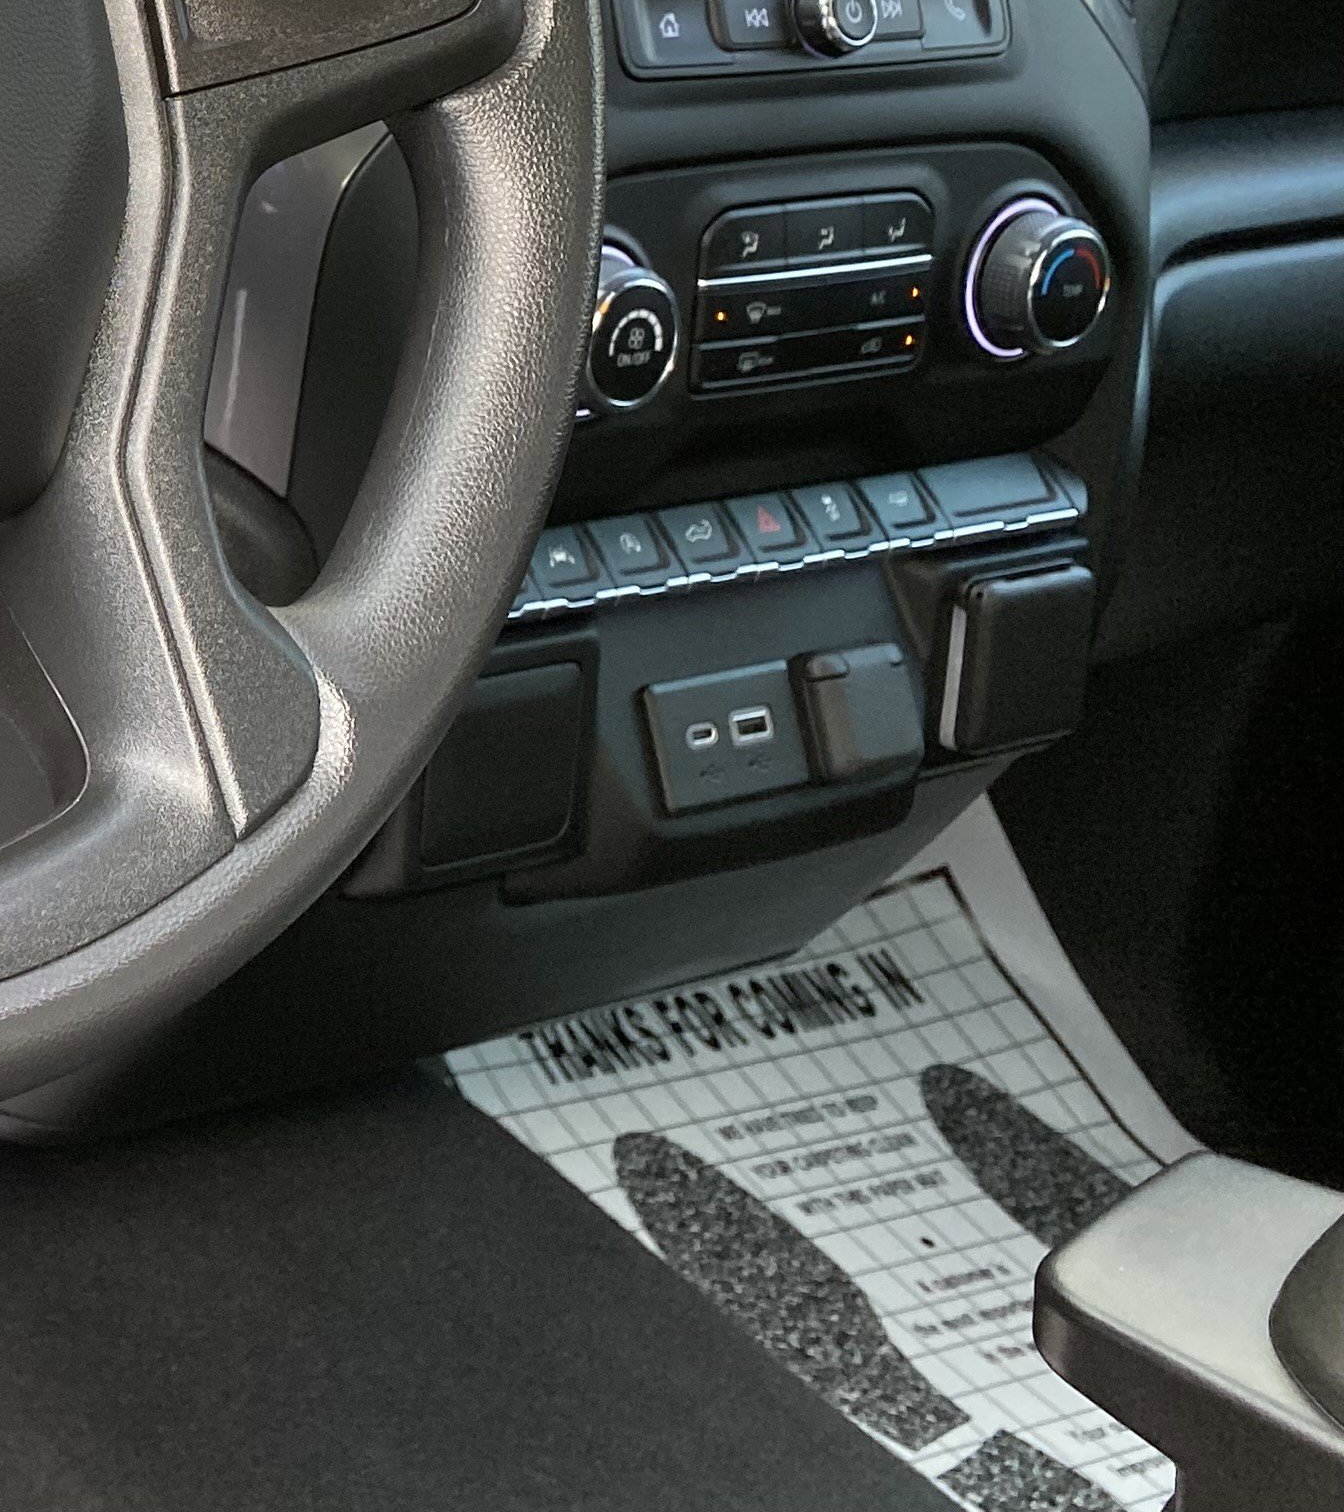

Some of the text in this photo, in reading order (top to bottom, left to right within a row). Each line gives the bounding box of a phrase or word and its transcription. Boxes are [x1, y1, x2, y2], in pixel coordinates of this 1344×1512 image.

[518, 948, 926, 1085] THANKS FOR COMING IN
